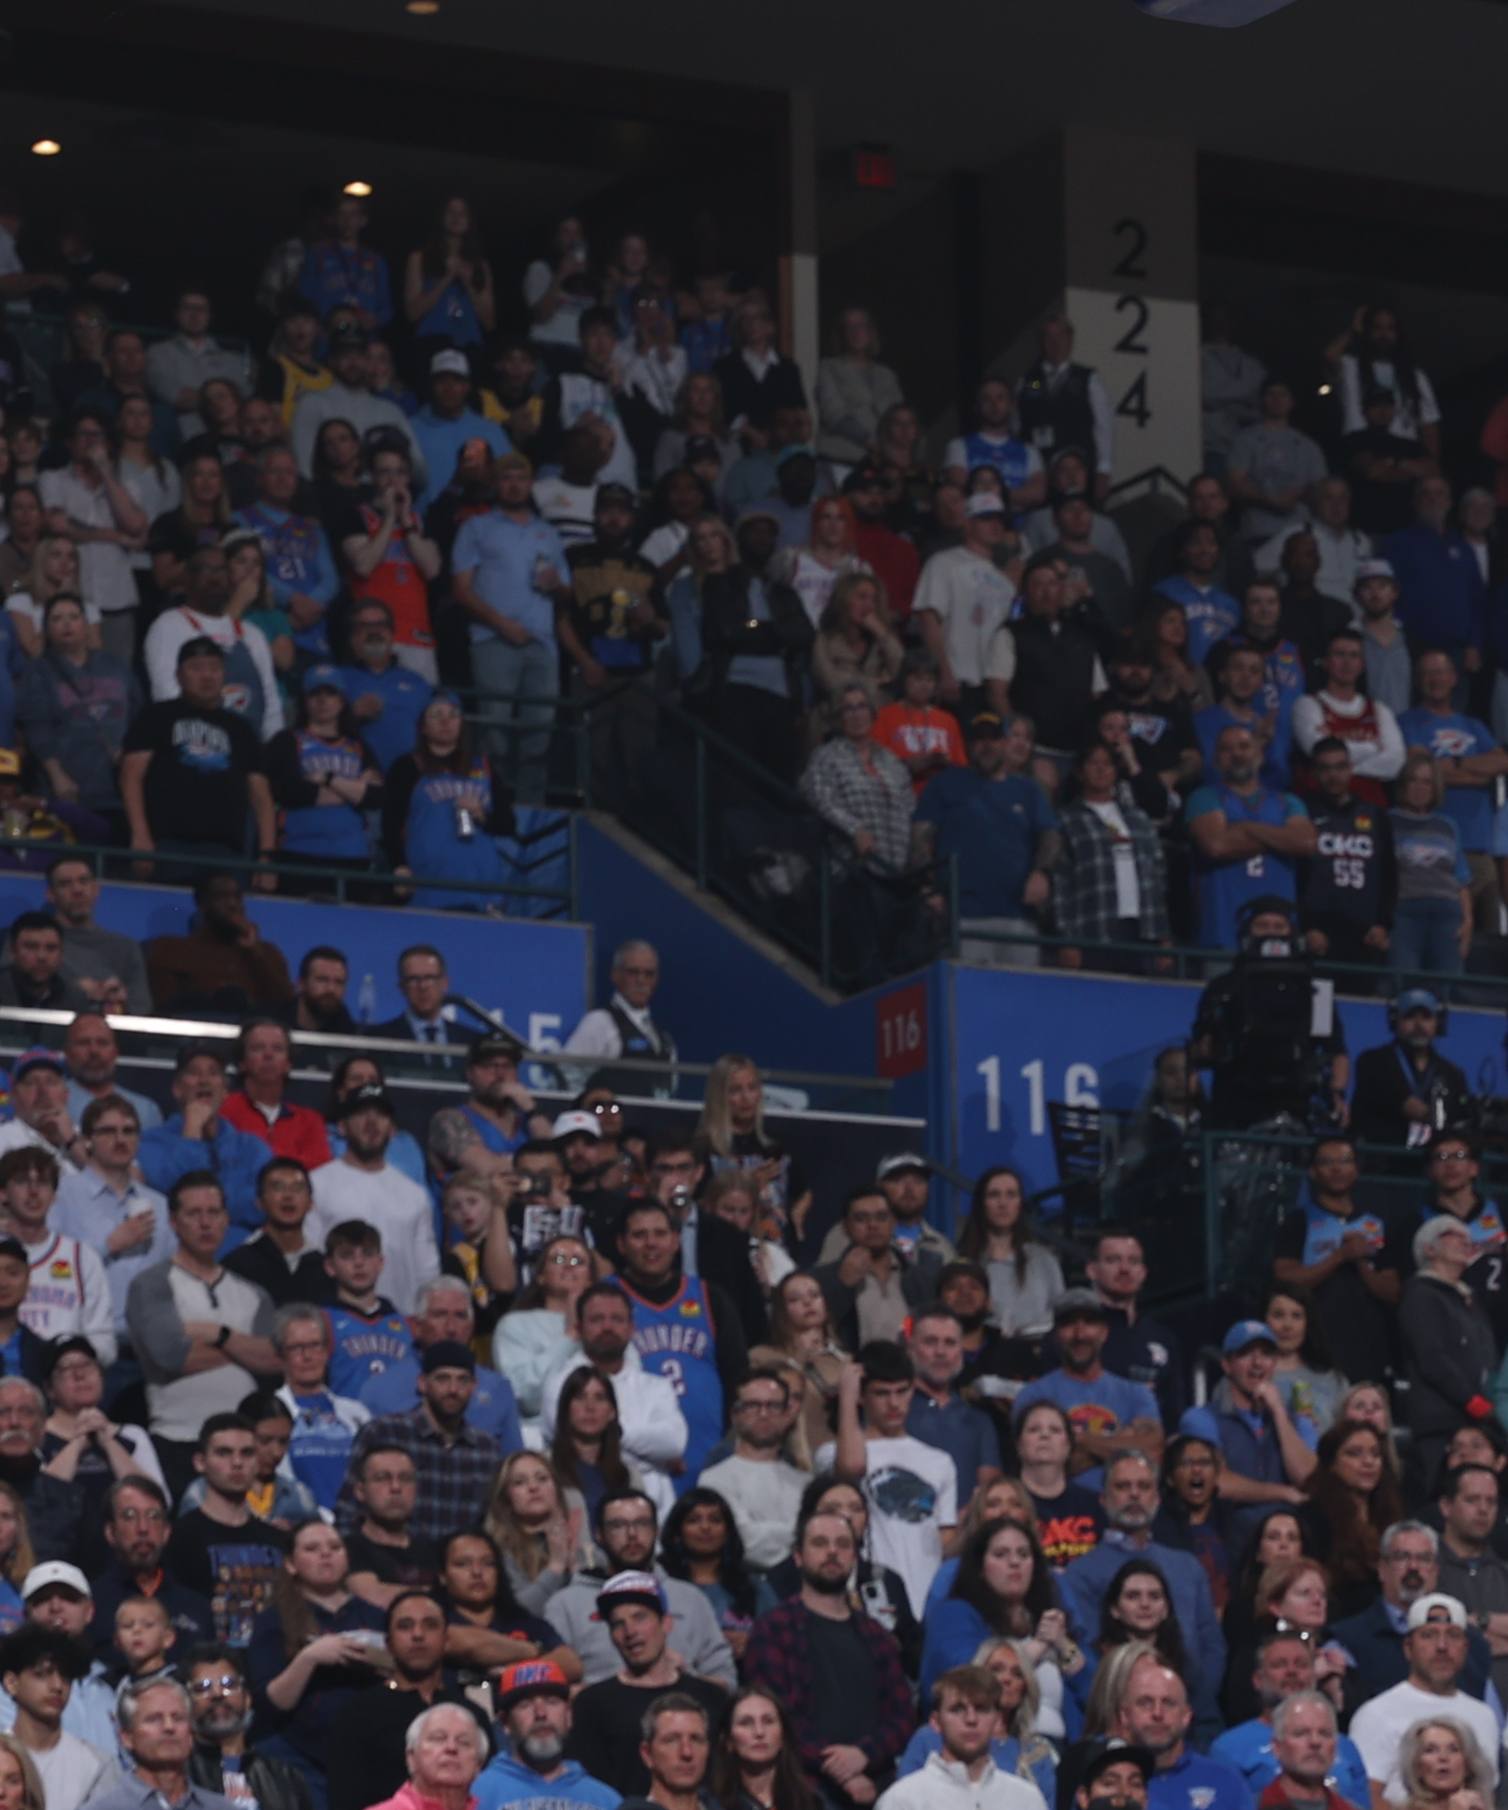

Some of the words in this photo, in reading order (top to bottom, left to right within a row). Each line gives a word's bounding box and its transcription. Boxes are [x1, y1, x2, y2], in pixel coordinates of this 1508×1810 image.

[1112, 218, 1151, 428] 224
[1333, 858, 1366, 889] 55
[882, 1008, 922, 1058] 116
[977, 1056, 1100, 1135] 116
[632, 1323, 708, 1360] HUNDER
